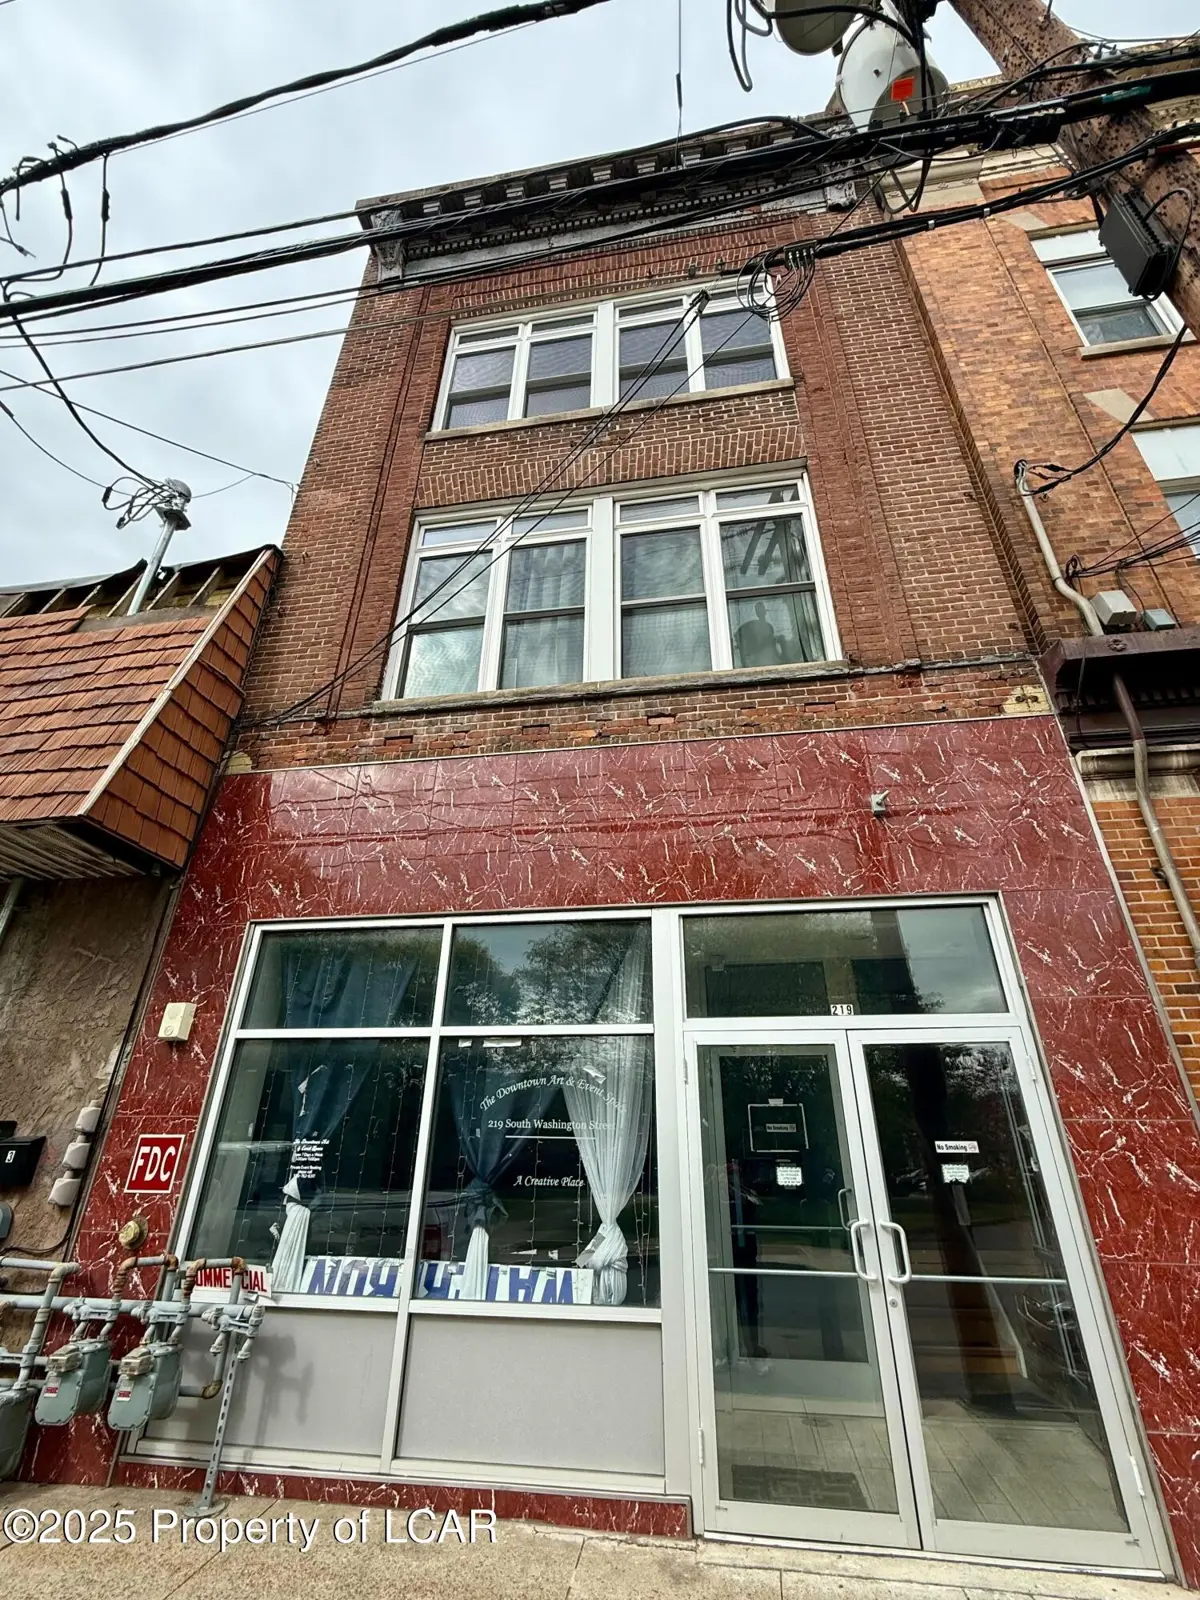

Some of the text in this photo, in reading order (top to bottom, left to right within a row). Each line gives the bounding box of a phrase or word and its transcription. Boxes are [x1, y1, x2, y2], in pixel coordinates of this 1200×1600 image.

[831, 1004, 853, 1016] 219
[479, 1094, 496, 1112] The
[496, 1076, 547, 1099] Downtown
[547, 1074, 565, 1087] Art
[566, 1076, 575, 1087] &
[577, 1078, 605, 1097] Event
[487, 1119, 504, 1130] 219
[505, 1118, 532, 1130] South
[533, 1118, 587, 1132] Washington
[936, 1143, 968, 1152] No Smoking
[131, 1145, 177, 1182] FDC
[513, 1175, 585, 1187] A Creative Place
[195, 1265, 268, 1293] OMMECIAL
